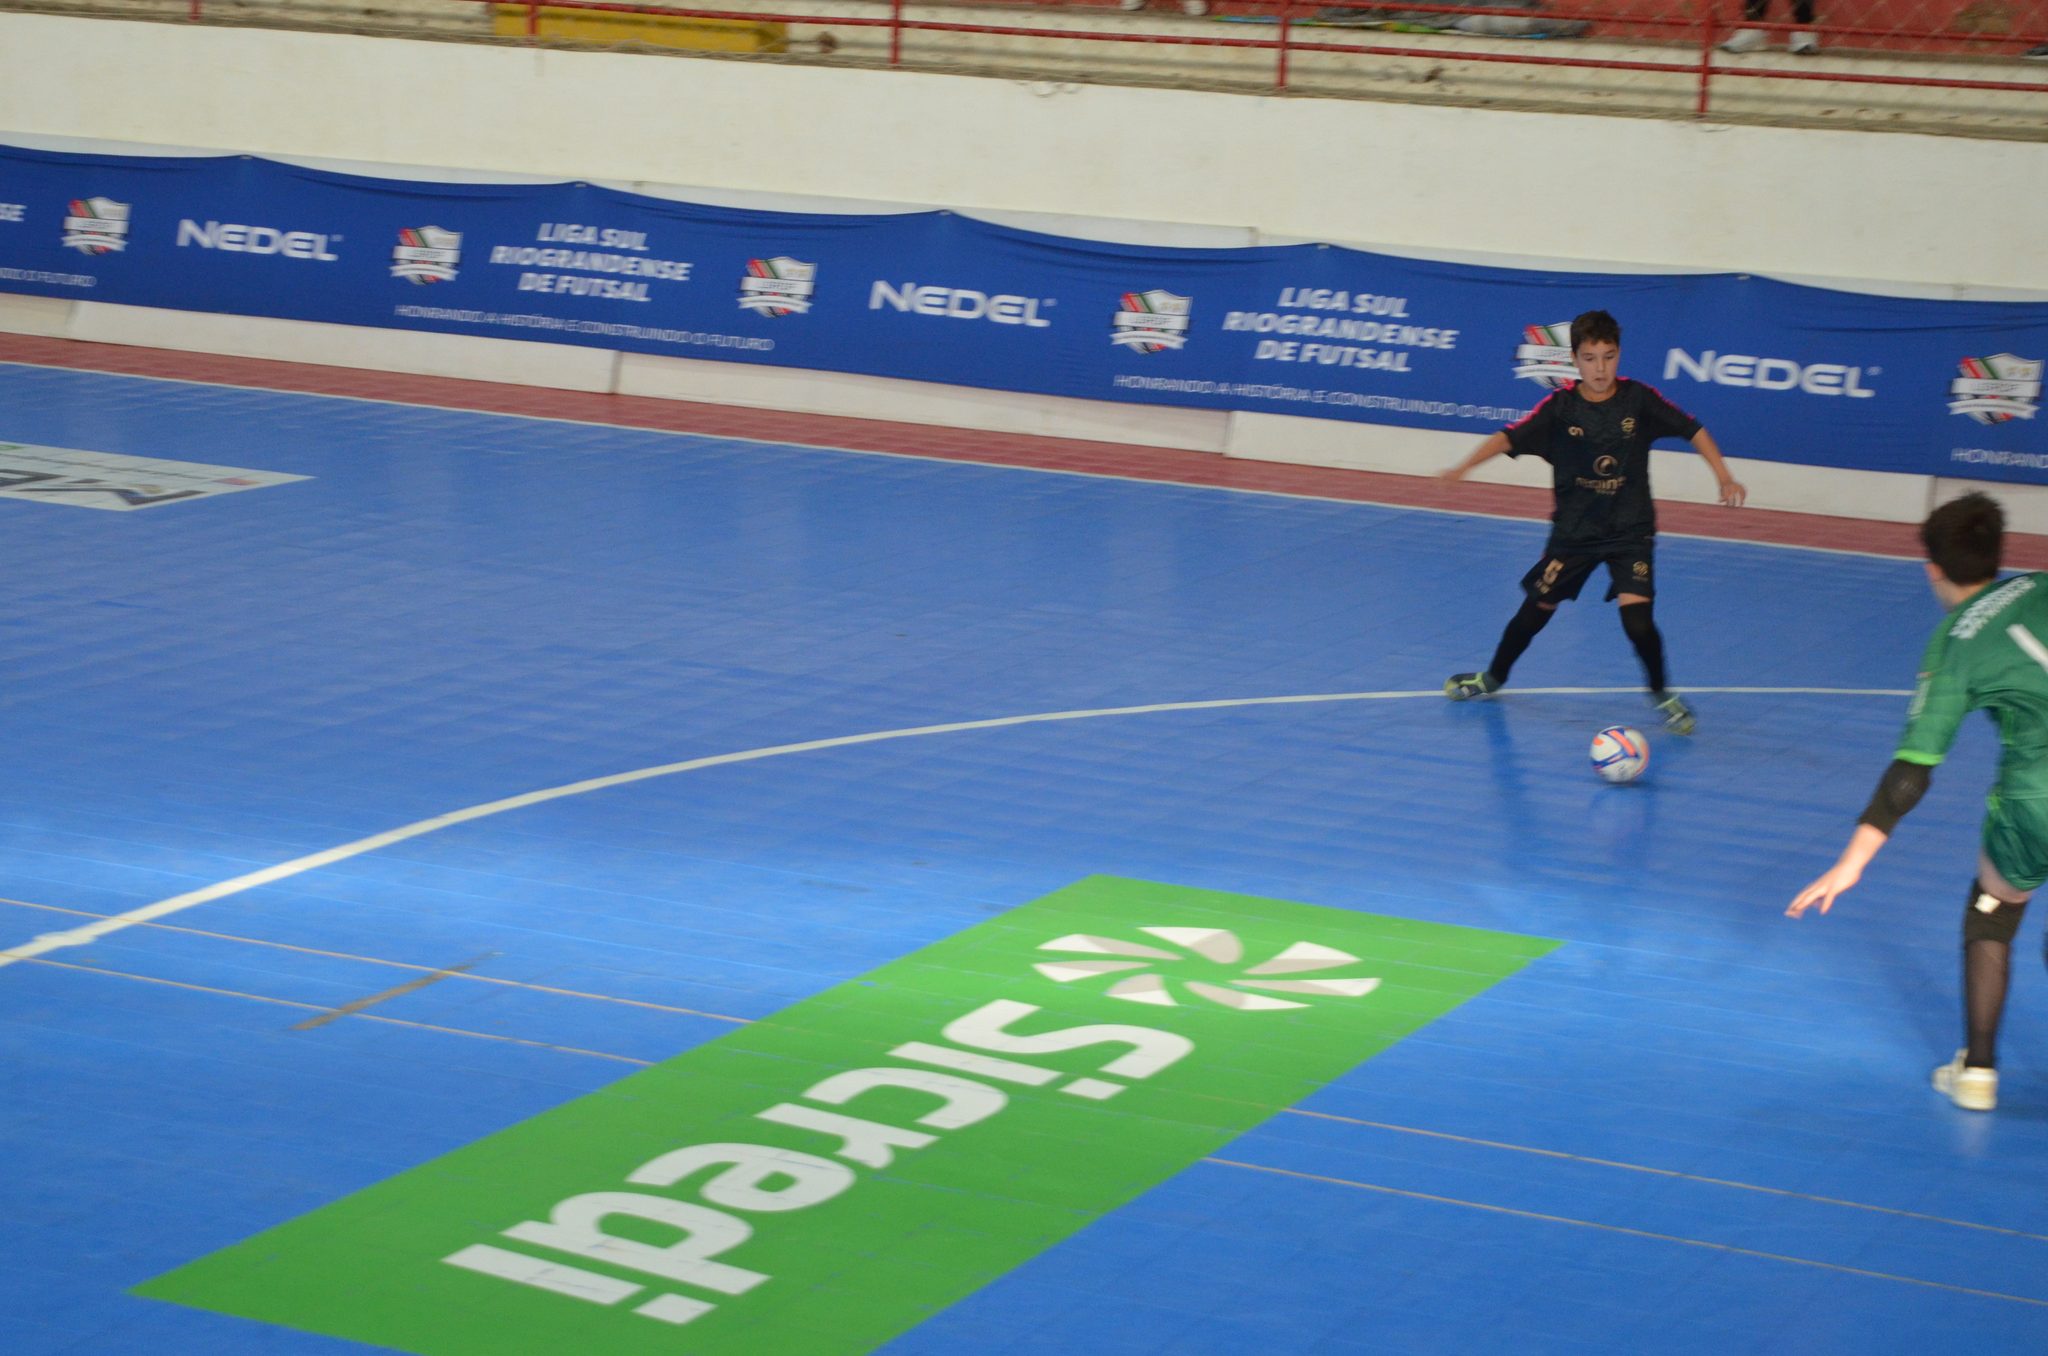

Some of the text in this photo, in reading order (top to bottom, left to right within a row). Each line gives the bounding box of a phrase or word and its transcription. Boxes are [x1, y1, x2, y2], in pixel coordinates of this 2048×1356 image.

[536, 223, 649, 251] LIGA SUL
[489, 246, 694, 281] RIOGRANDENSE
[517, 273, 652, 302] DE FUTSAL
[1277, 287, 1410, 318] LIGA SUL
[1222, 311, 1460, 349] RIOGRANDENSE
[1254, 340, 1412, 372] DE FUTSAL
[440, 999, 1195, 1325] Sicredi
